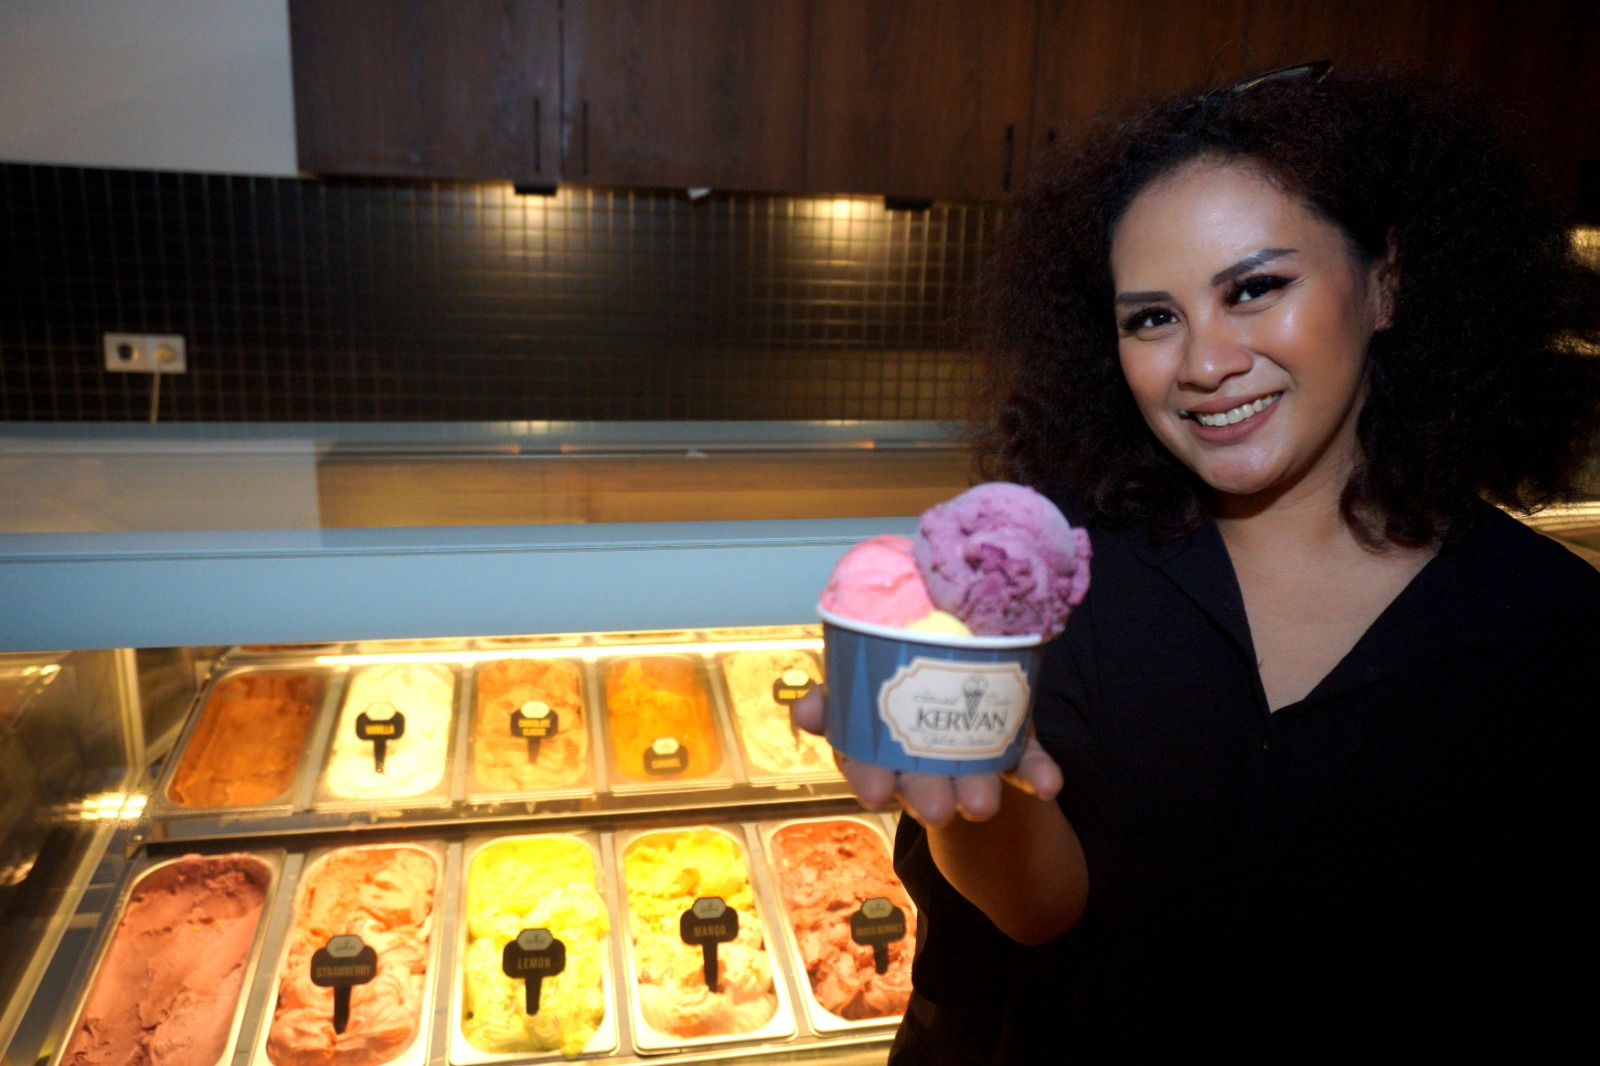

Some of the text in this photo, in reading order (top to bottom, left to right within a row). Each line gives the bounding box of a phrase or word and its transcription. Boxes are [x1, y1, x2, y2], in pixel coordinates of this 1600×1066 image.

[914, 706, 1009, 732] KERVAN
[694, 924, 726, 937] MANGO
[517, 957, 551, 969] LEMON
[316, 965, 371, 979] STRAWBERRY
